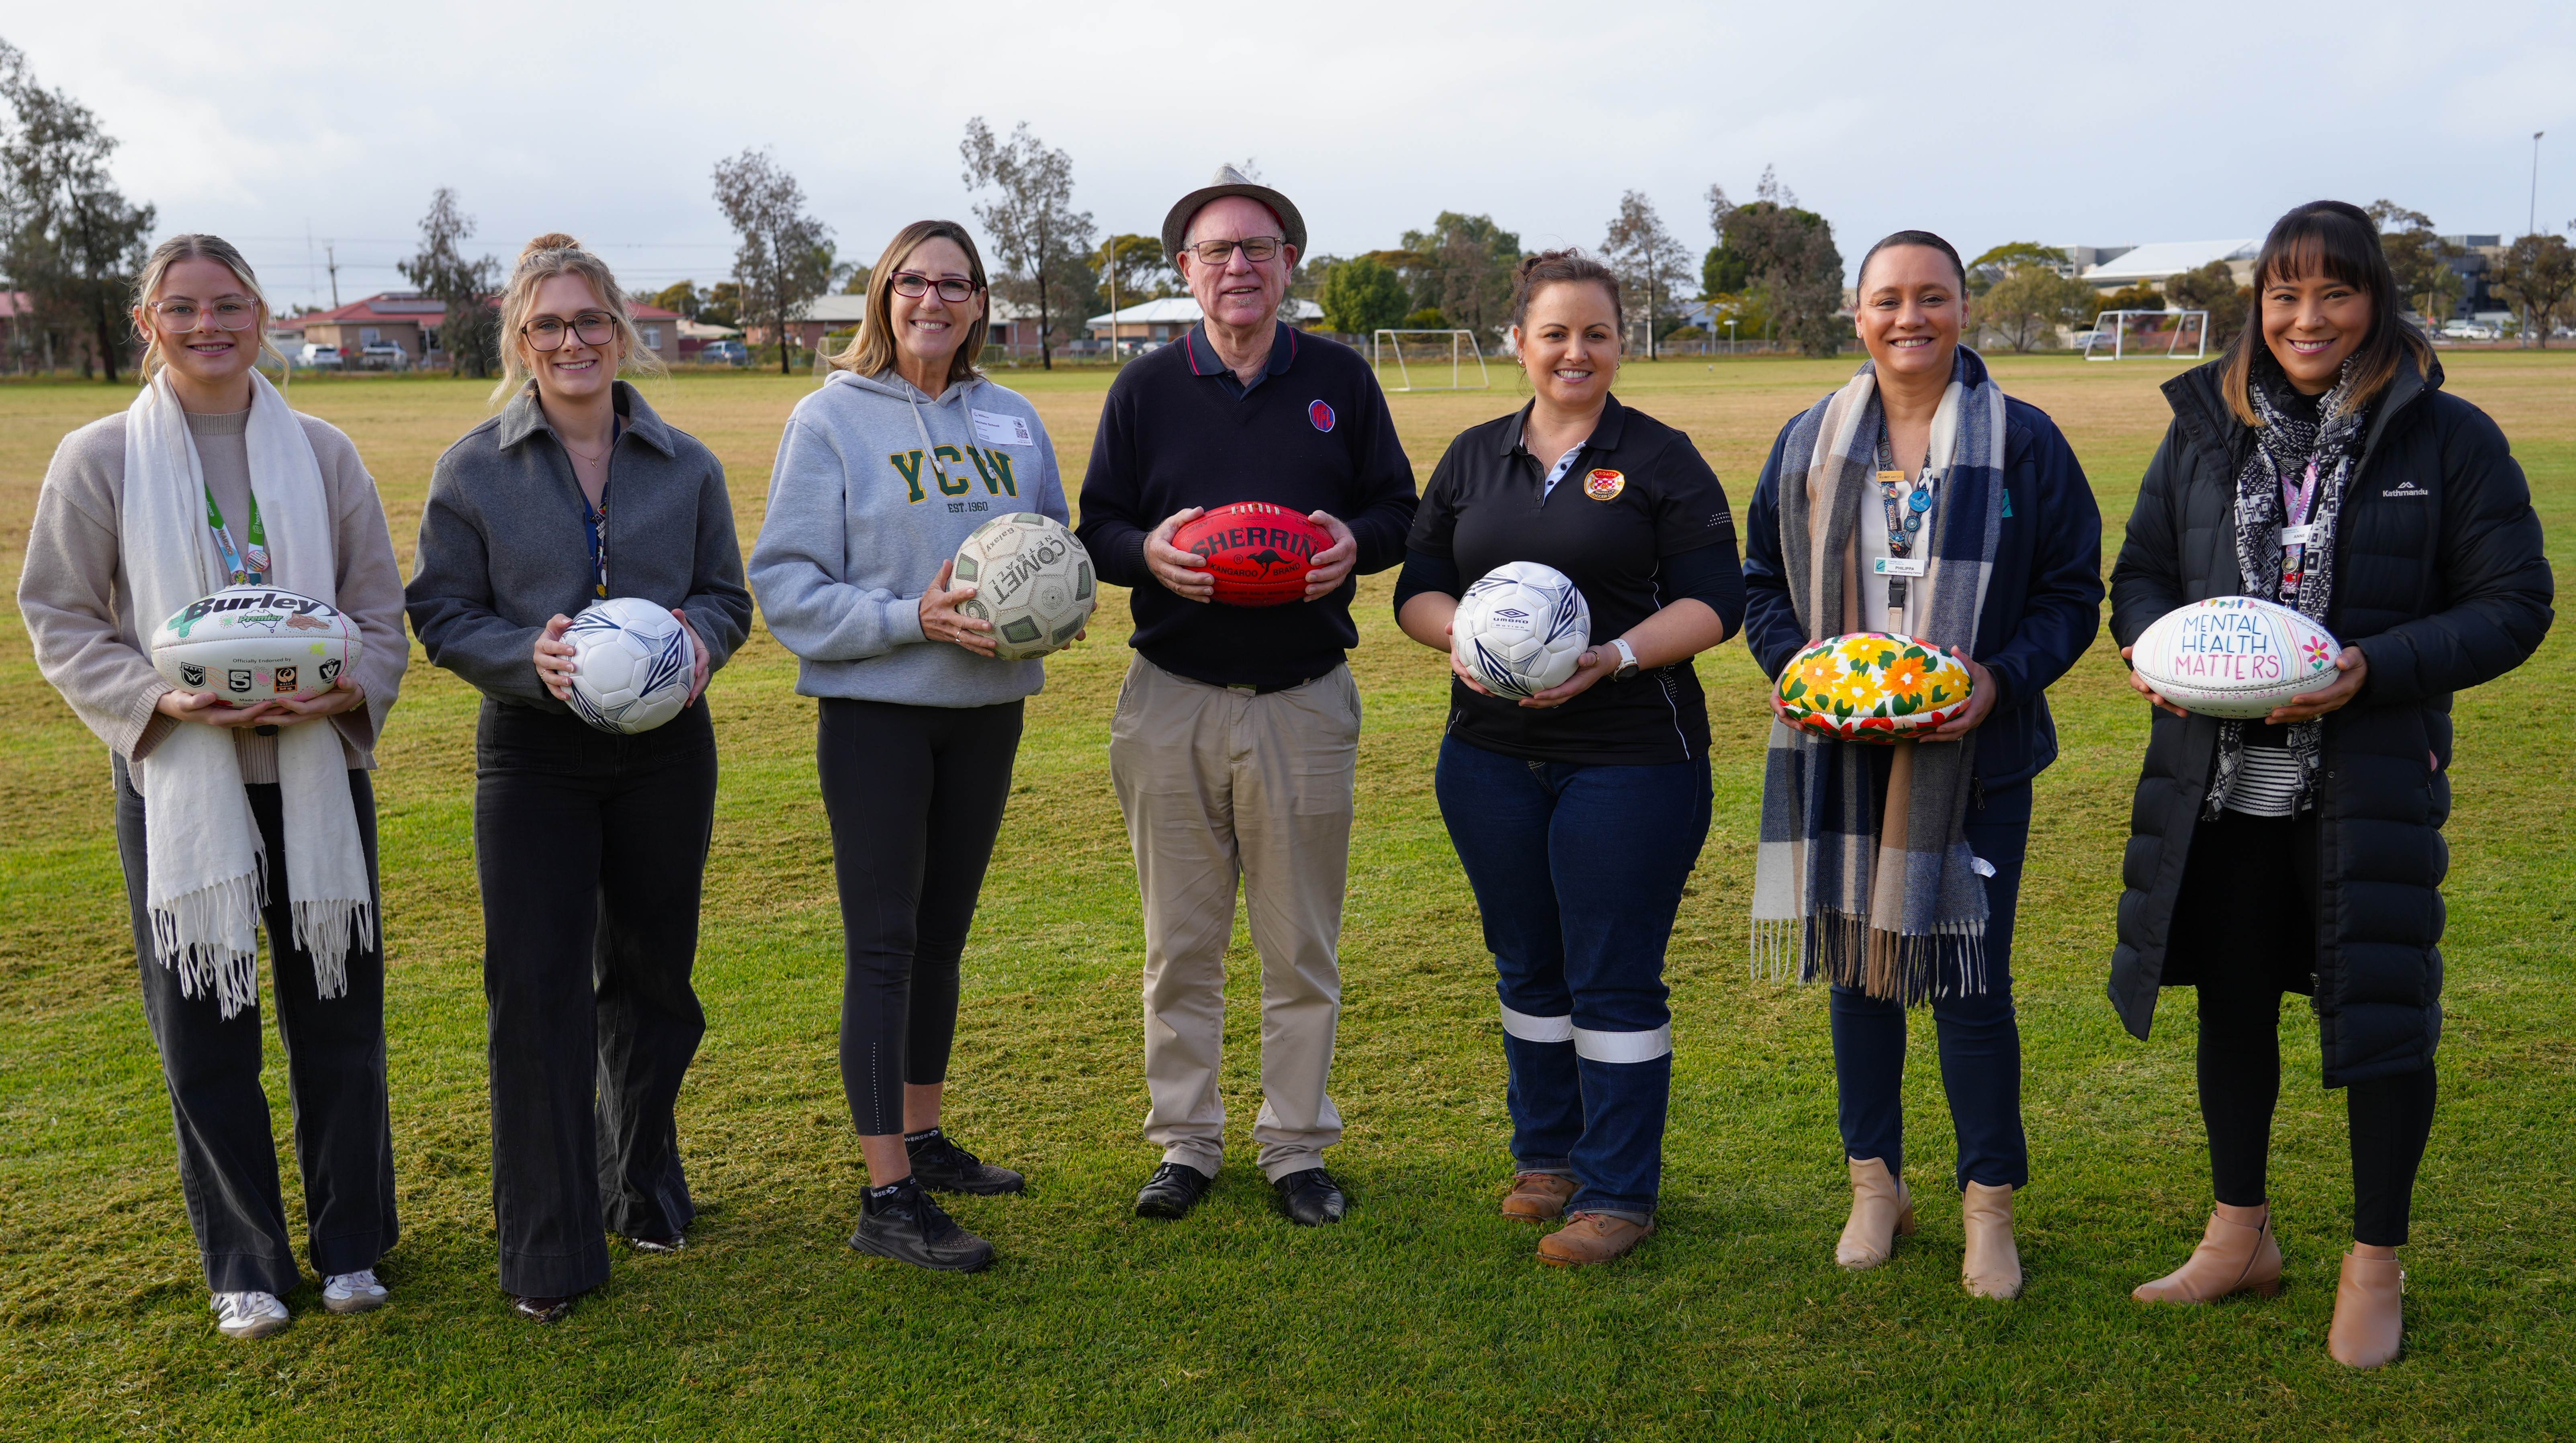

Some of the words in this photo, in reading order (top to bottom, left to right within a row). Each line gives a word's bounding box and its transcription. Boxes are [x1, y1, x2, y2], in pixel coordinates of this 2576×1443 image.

[889, 444, 1019, 505] YCW
[2383, 488, 2428, 497] Kathmandu
[218, 529, 234, 556] NAIDOC
[986, 527, 1014, 552] Galaxy
[1190, 527, 1319, 564] SHERRIN
[988, 535, 1052, 585] NETBALL
[1210, 562, 1258, 577] KANGAROO
[1273, 562, 1301, 576] BRAND
[994, 539, 1066, 605] COMET
[184, 593, 316, 623] Burley
[238, 614, 283, 623] Premier
[2183, 613, 2262, 635] MENTAL
[2182, 634, 2267, 654] HEALTH
[2175, 654, 2280, 681] MATTERS
[231, 671, 250, 688] S
[2165, 688, 2190, 698] August
[2253, 690, 2282, 699] 2024
[904, 1134, 929, 1142] NVERSE
